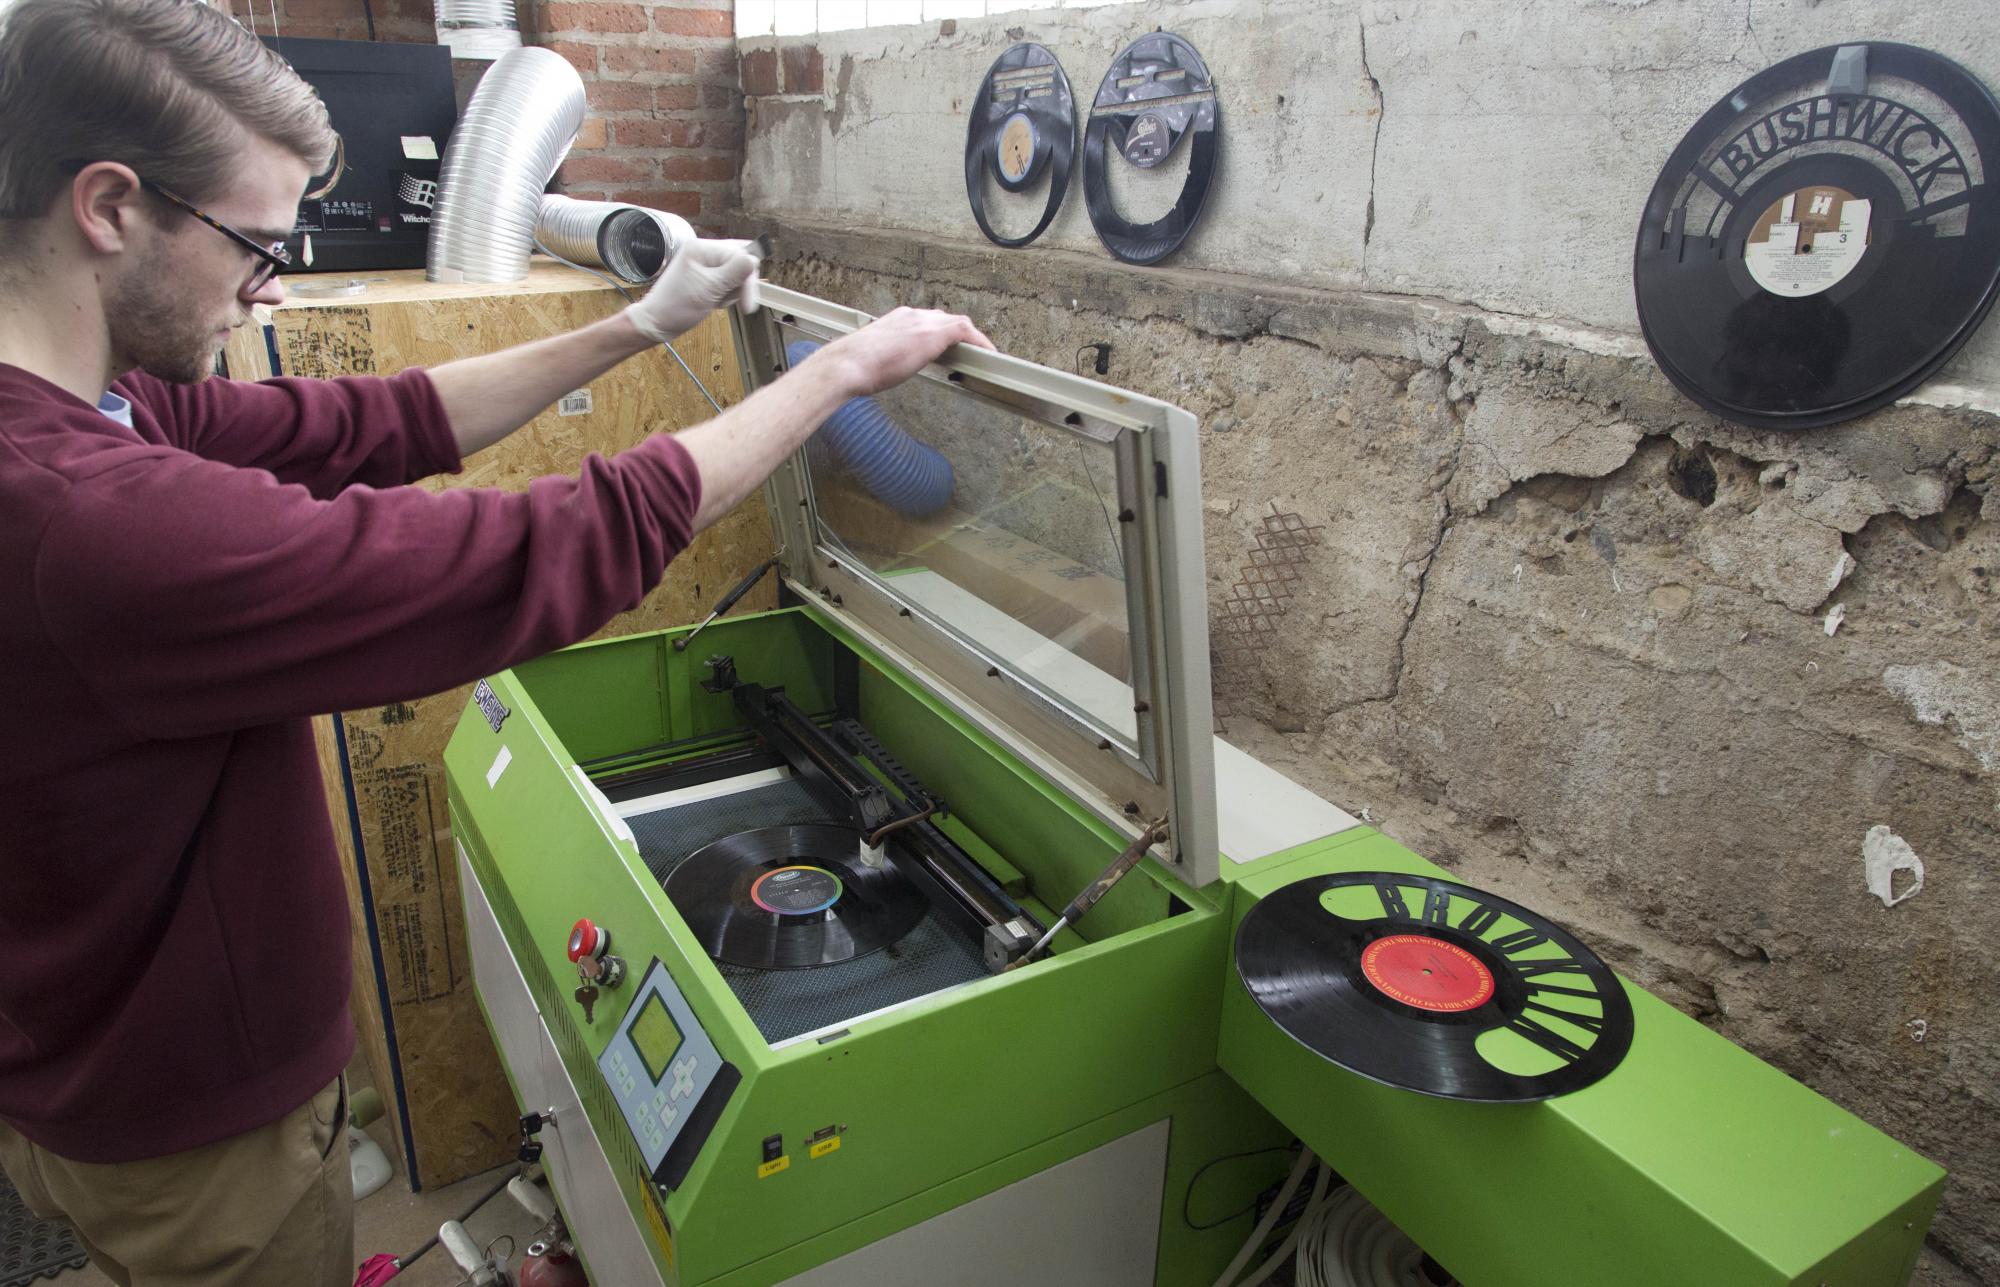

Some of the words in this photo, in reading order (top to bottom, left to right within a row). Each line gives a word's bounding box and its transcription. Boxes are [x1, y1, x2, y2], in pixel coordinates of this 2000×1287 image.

[1721, 98, 1967, 200] BUSHWICK
[1839, 233, 1848, 244] 3
[1376, 883, 1603, 1067] BROOKLYN
